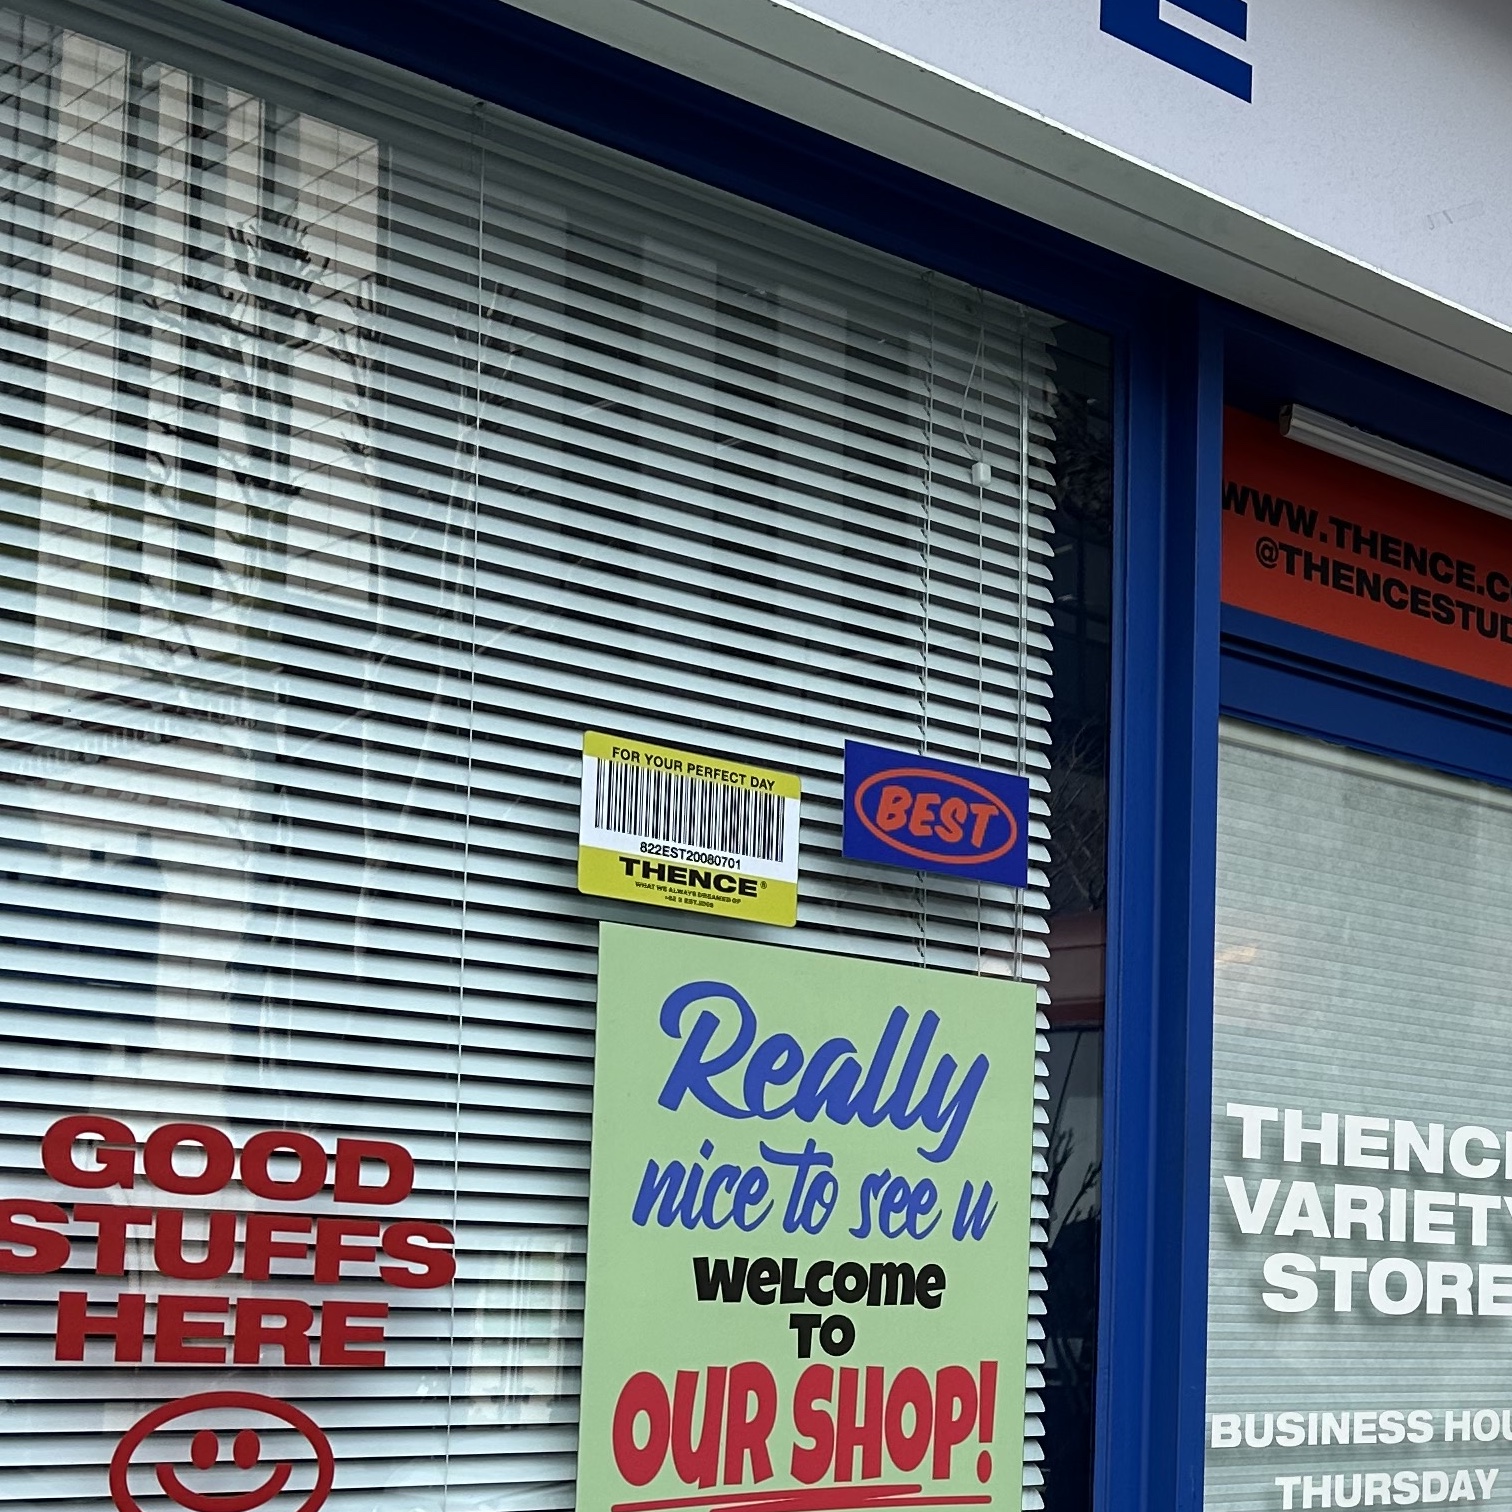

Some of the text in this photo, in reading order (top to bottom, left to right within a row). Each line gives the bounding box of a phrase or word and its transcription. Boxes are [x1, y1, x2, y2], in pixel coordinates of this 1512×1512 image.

[612, 746, 776, 791] FOR YOUR PERFECT DAY
[875, 785, 999, 849] BEST
[639, 841, 741, 870] 822EST20080701
[657, 980, 990, 1163] Really
[41, 1114, 415, 1205] GOOD
[632, 1138, 998, 1242] nice to see u
[0, 1198, 457, 1289] STUFFS
[55, 1291, 389, 1367] HERE
[789, 1313, 856, 1359] TO
[612, 1360, 998, 1489] OUR SHOP!
[1210, 1410, 1434, 1448] BUSINESS
[1275, 1468, 1500, 1510] THURSDAY
